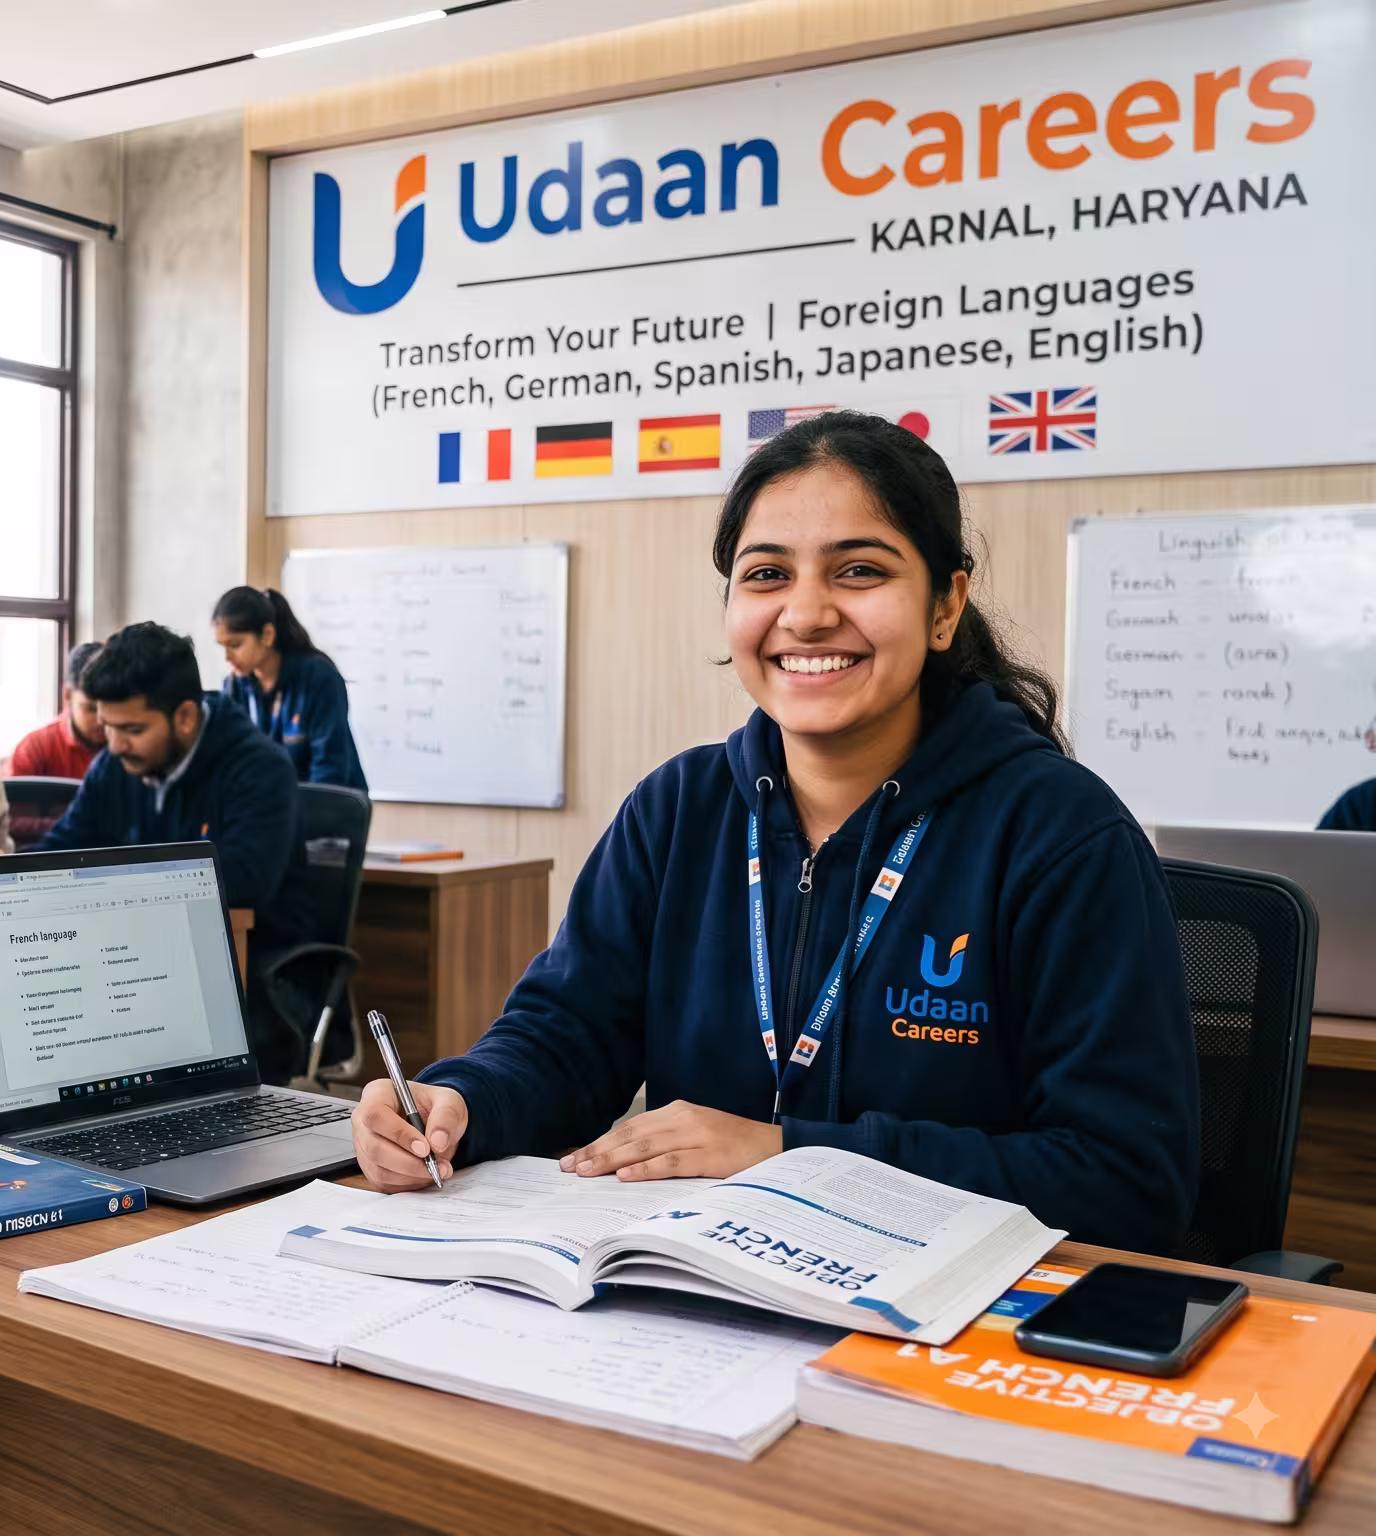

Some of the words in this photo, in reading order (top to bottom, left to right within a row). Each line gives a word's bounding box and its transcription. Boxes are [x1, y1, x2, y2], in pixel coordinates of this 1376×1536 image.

[460, 137, 779, 243] Udaan
[821, 58, 1316, 196] Careers
[871, 204, 1056, 253] KARNAL,
[1073, 173, 1308, 231] HARYANA
[380, 331, 535, 369] Transform
[547, 324, 619, 355] Your
[632, 307, 745, 345] Future
[798, 291, 943, 332] Foreign
[960, 268, 1194, 317] Languages
[372, 382, 494, 417] (French,
[505, 370, 642, 404] German,
[654, 348, 804, 395] Spanish,
[816, 338, 1012, 381] Japanese,
[1029, 312, 1204, 364] English)
[9, 932, 39, 945] French
[40, 930, 77, 942] language
[886, 986, 988, 1023] Udaan
[892, 1018, 979, 1044] Careers
[716, 1220, 879, 1283] FRENCH
[944, 1369, 1223, 1431] OBJECTIVE
[976, 1358, 1236, 1416] FRENCH
